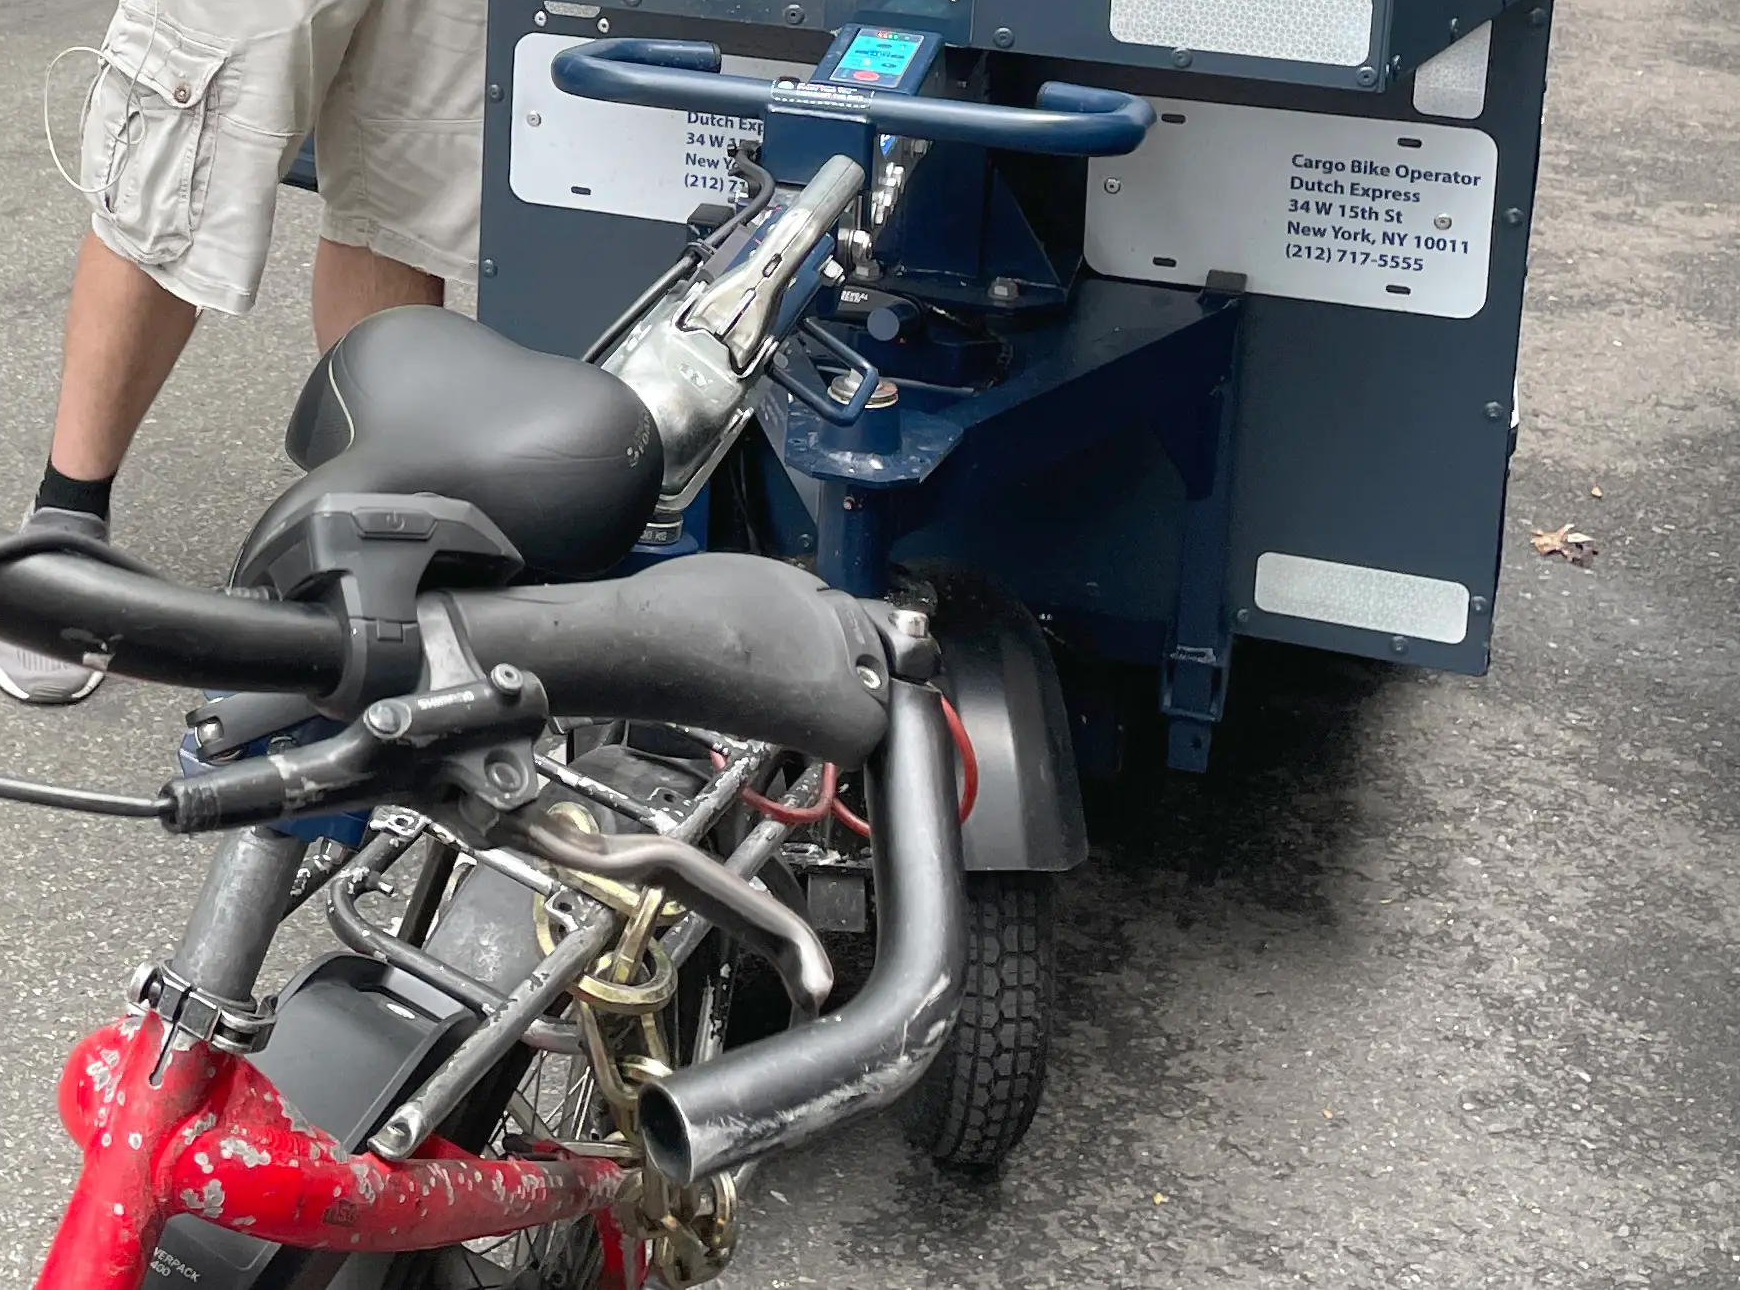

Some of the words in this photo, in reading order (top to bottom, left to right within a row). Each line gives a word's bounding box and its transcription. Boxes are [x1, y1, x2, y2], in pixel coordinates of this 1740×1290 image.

[687, 112, 734, 129] Dutch
[739, 119, 764, 136] Exp
[686, 132, 705, 145] 34
[709, 135, 724, 148] W
[685, 152, 719, 169] New
[1292, 154, 1346, 175] Cargo
[1351, 159, 1390, 177] Bike
[1395, 165, 1481, 187] Operator
[684, 174, 724, 192] (212)
[1290, 176, 1344, 195] Dutch
[1349, 182, 1420, 203] Express
[1288, 199, 1310, 214] 34
[1315, 202, 1332, 215] W
[1339, 204, 1379, 221] 15th
[1384, 209, 1403, 224] St
[1287, 220, 1327, 237] New
[1332, 225, 1376, 245] York,
[1382, 232, 1408, 247] NY
[1414, 235, 1469, 254] 10011
[1286, 243, 1332, 263] (212)
[1337, 248, 1424, 271] 717-5555
